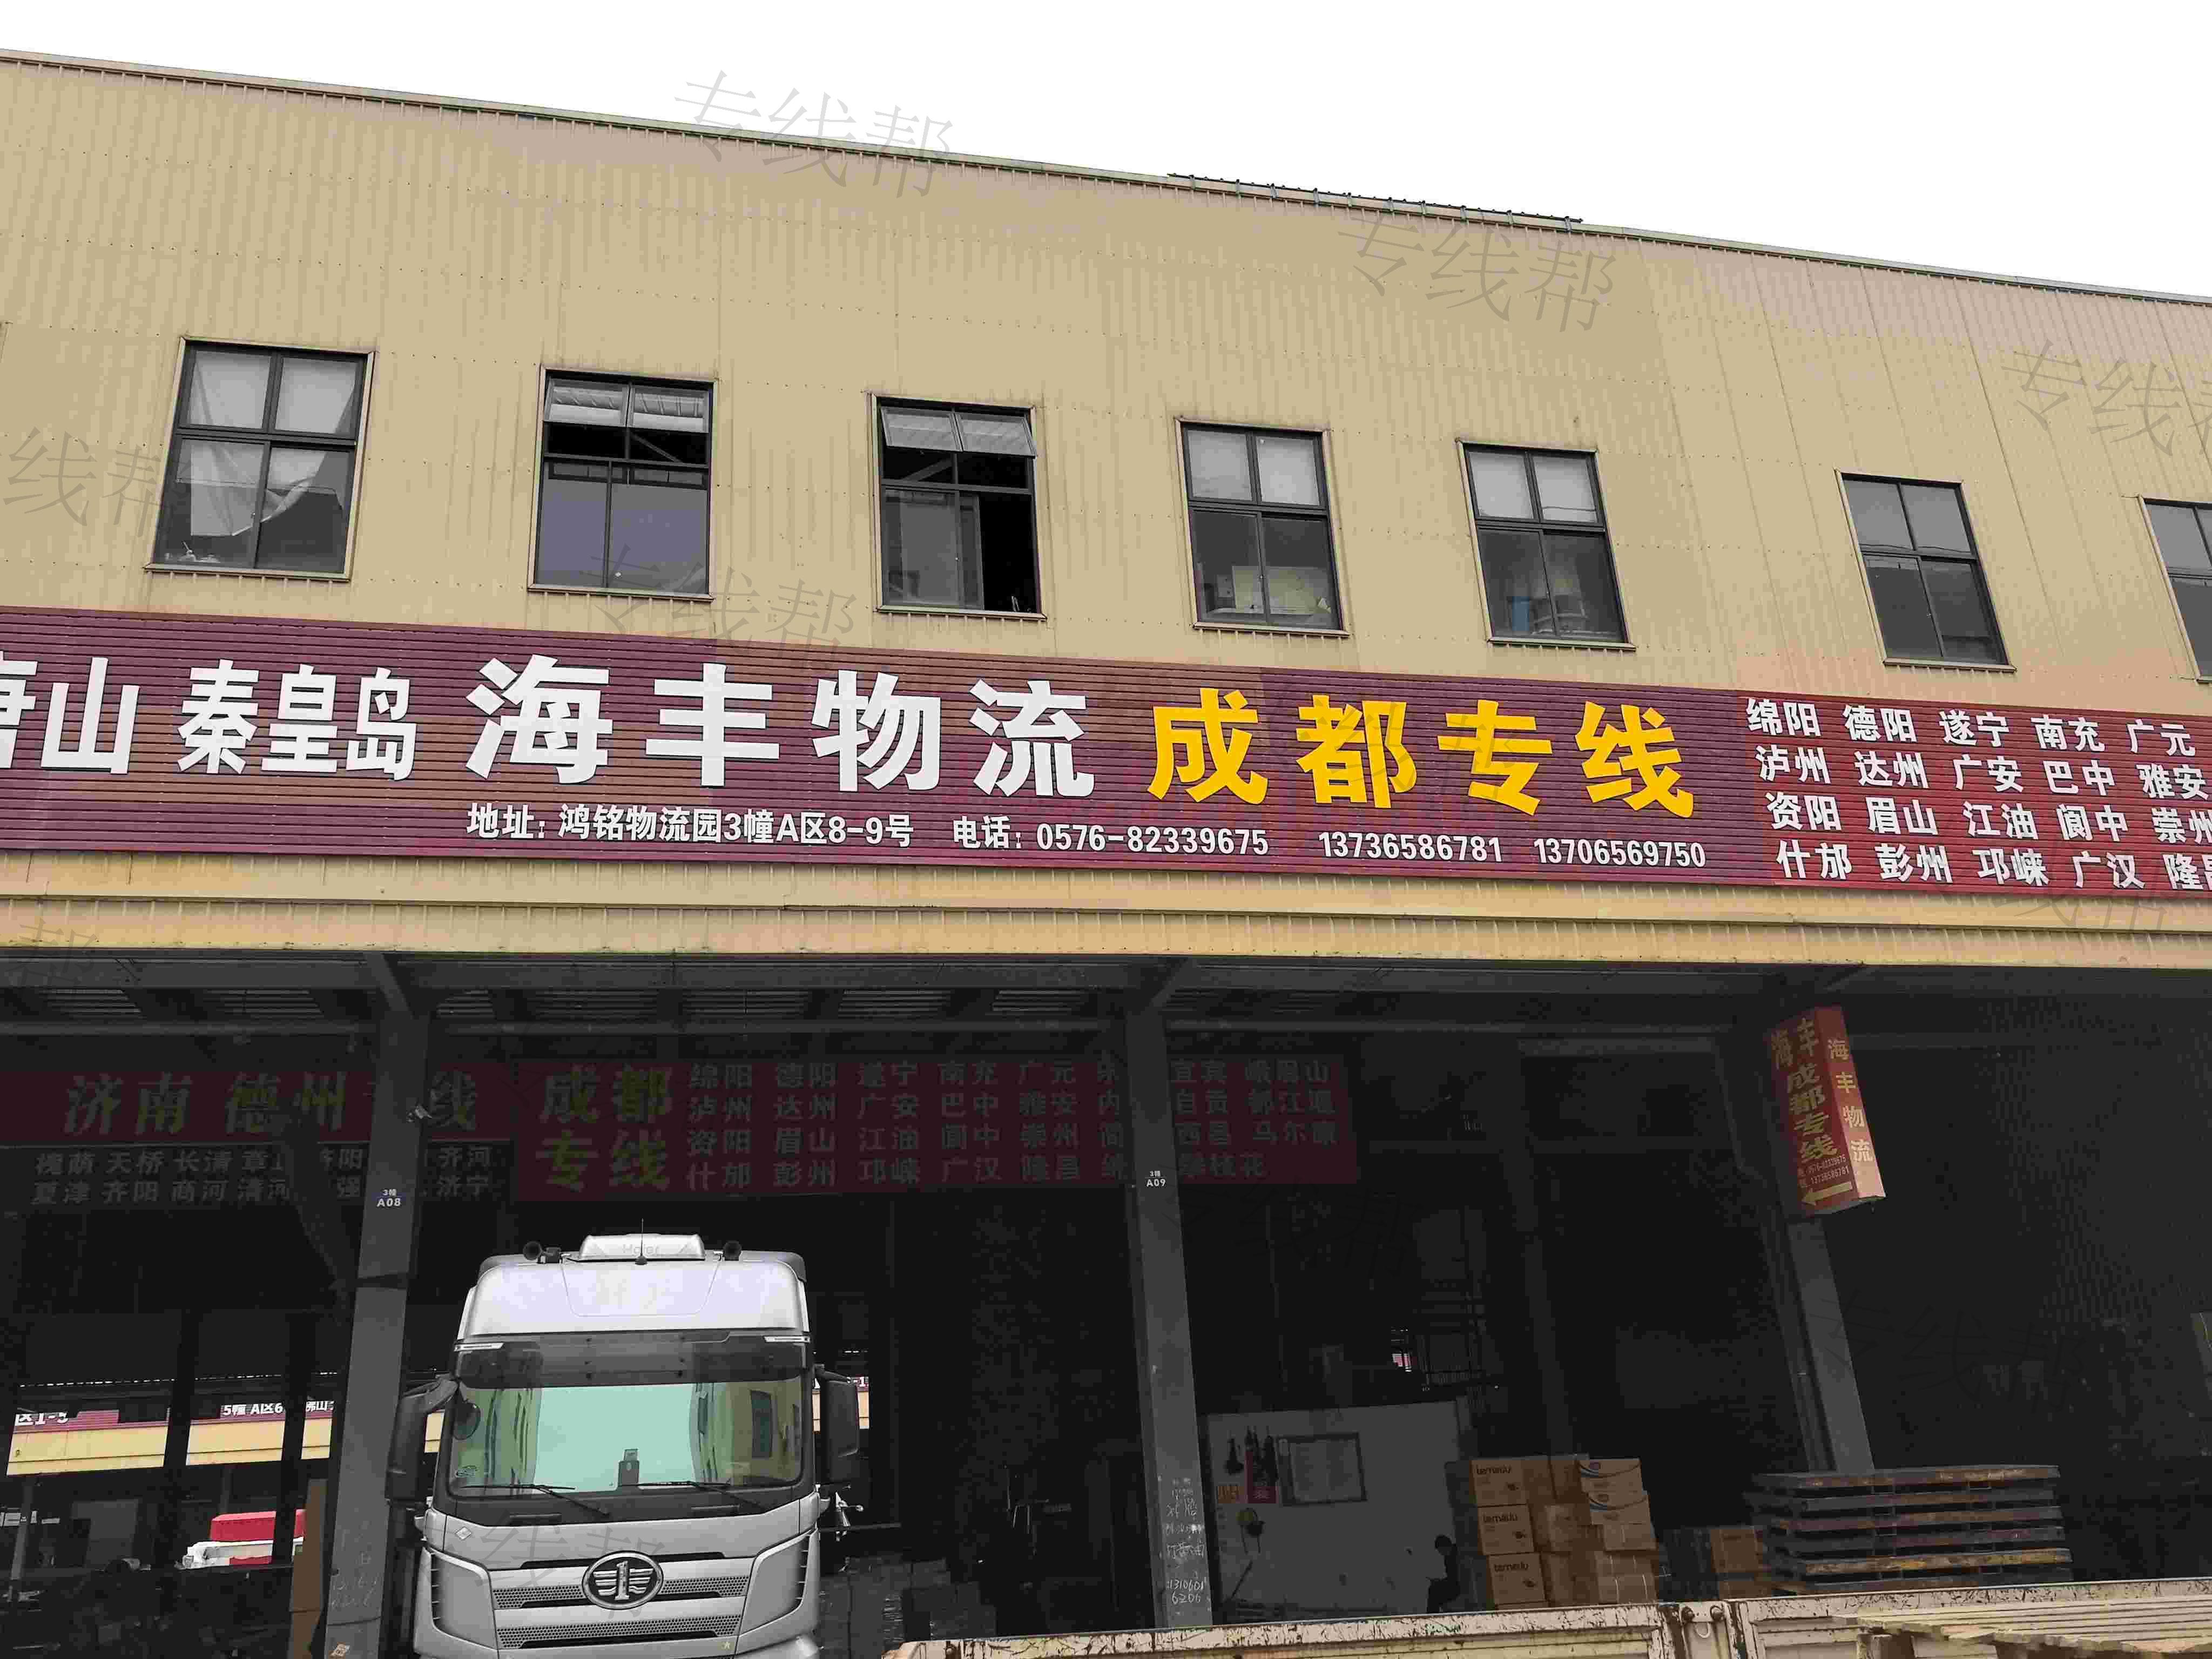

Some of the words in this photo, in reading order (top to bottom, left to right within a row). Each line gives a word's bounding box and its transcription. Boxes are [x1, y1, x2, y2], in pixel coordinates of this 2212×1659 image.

[178, 658, 417, 781] 秦皇岛
[465, 654, 1095, 797] 海丰物流
[1147, 687, 1694, 818] 成都专线
[1746, 698, 1821, 737] 绵阳
[1843, 705, 1917, 743] 德阳
[1939, 709, 2009, 748] 遂宁
[2031, 714, 2105, 752] 南充
[2126, 719, 2196, 756] 广元
[1755, 744, 1831, 784] 泸州
[1854, 751, 1929, 788] 达州
[1953, 754, 2024, 792] 广安
[2043, 759, 2115, 796] 巴中
[2136, 763, 2209, 800] 雅安
[1765, 792, 1842, 831] 资阳
[1865, 797, 1939, 835] 眉山
[1963, 801, 2039, 840] 江油
[2056, 804, 2129, 842] 阆中
[2151, 807, 2212, 844] 崇州
[1319, 831, 1502, 862] 13736586781
[1534, 838, 1706, 868] 13706569750
[1776, 839, 1852, 880] 什邡
[1875, 843, 1953, 884] 彭州
[1972, 848, 2049, 886] 邛崃
[2072, 851, 2146, 889] 广汉
[59, 1072, 192, 1135] 济南
[362, 1071, 477, 1131] 线
[540, 1063, 670, 1123] 成都
[1827, 1037, 1873, 1163] 海丰物流
[536, 1130, 670, 1192] 专线
[1146, 1178, 1166, 1188] A09
[376, 1197, 401, 1207] A08
